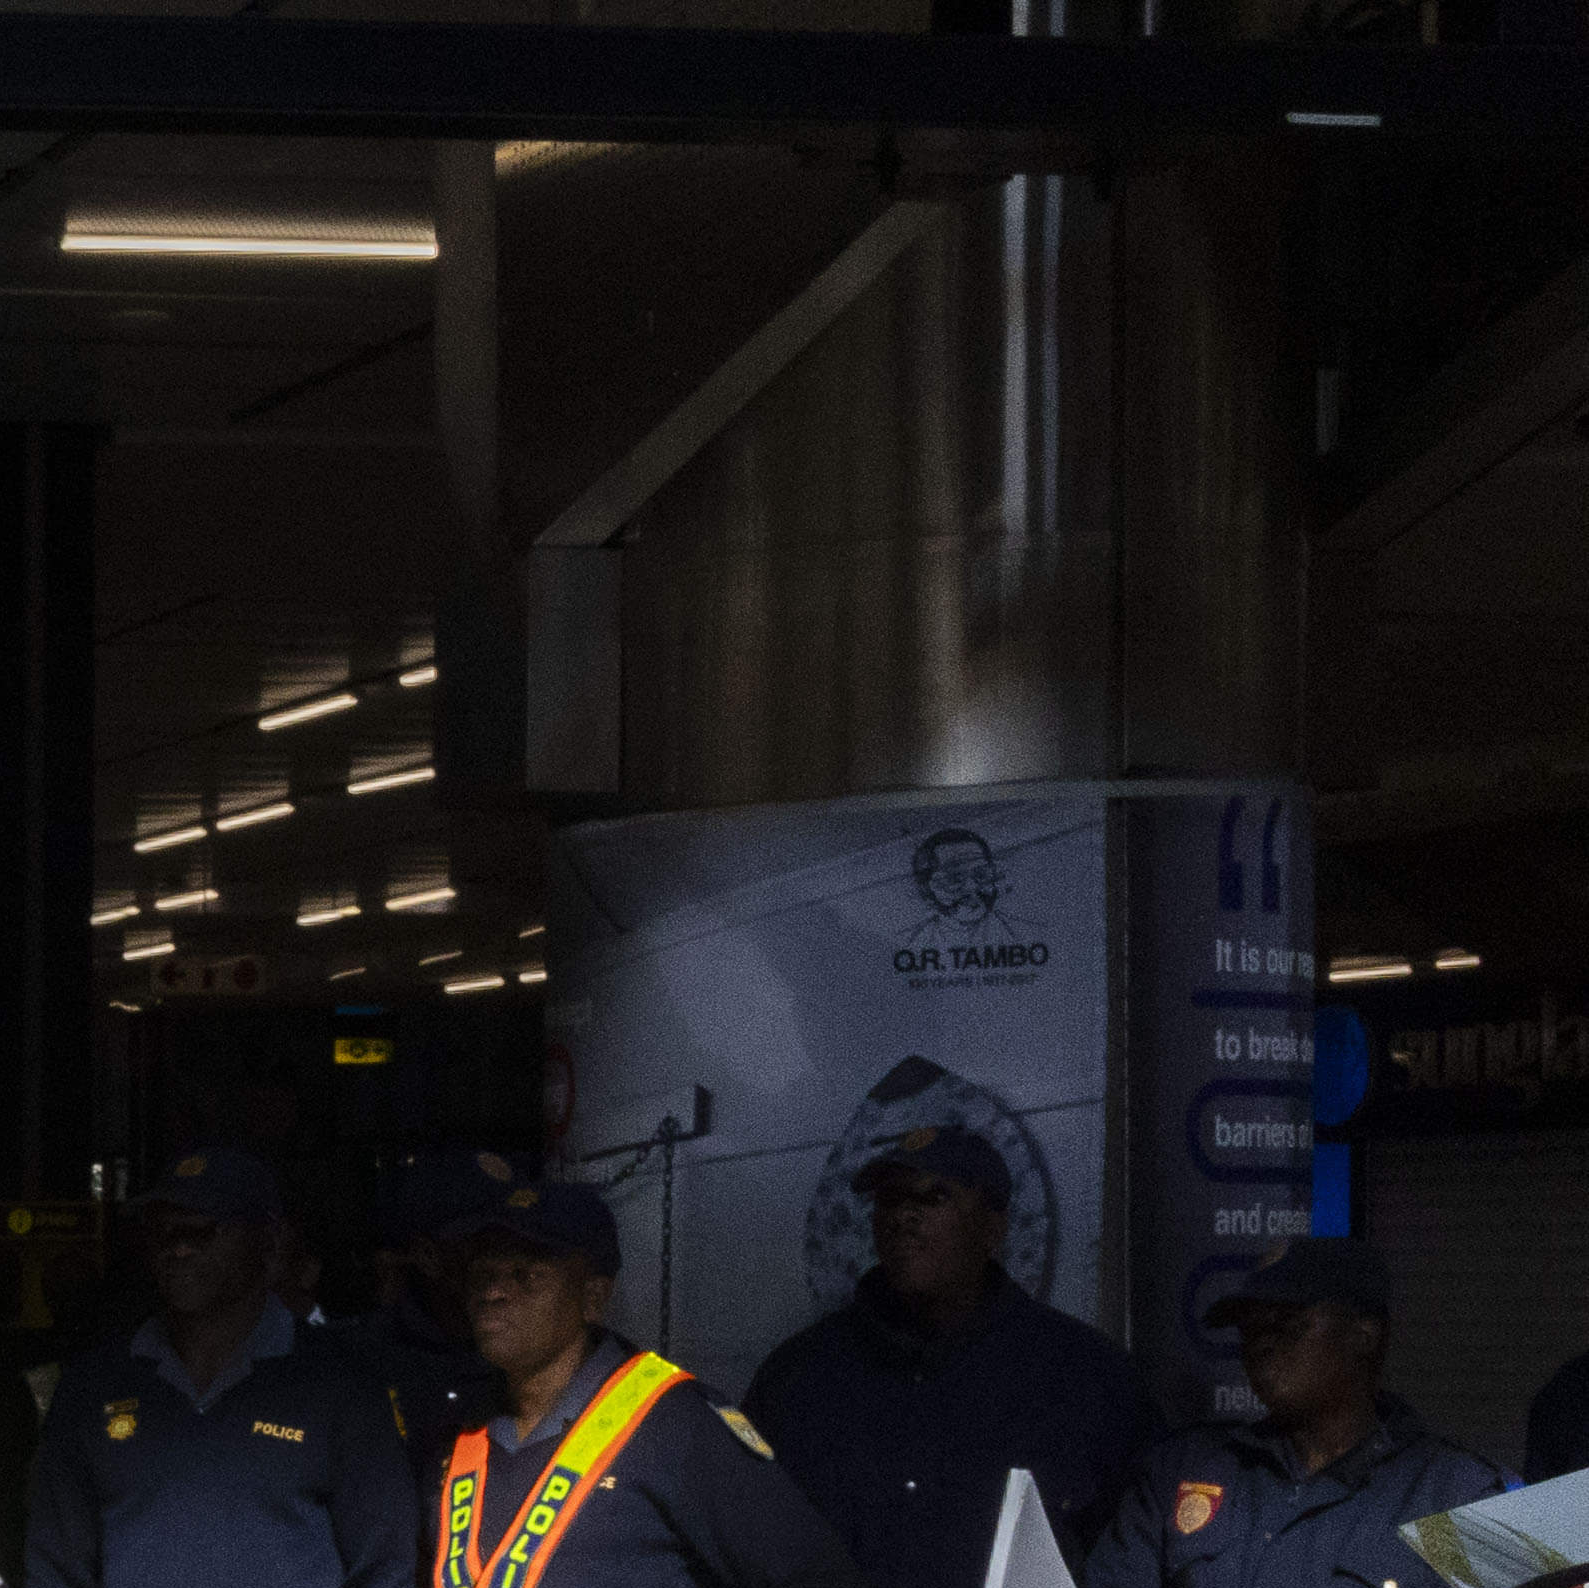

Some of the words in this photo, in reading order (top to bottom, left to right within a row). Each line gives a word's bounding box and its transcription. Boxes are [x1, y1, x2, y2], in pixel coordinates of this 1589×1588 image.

[948, 942, 1049, 970] TAMBO
[1215, 939, 1233, 973] It
[1241, 938, 1261, 974] is
[1215, 1029, 1241, 1061] to
[1215, 1114, 1295, 1149] barriers
[1215, 1203, 1261, 1232] and
[253, 1420, 305, 1443] POLICE
